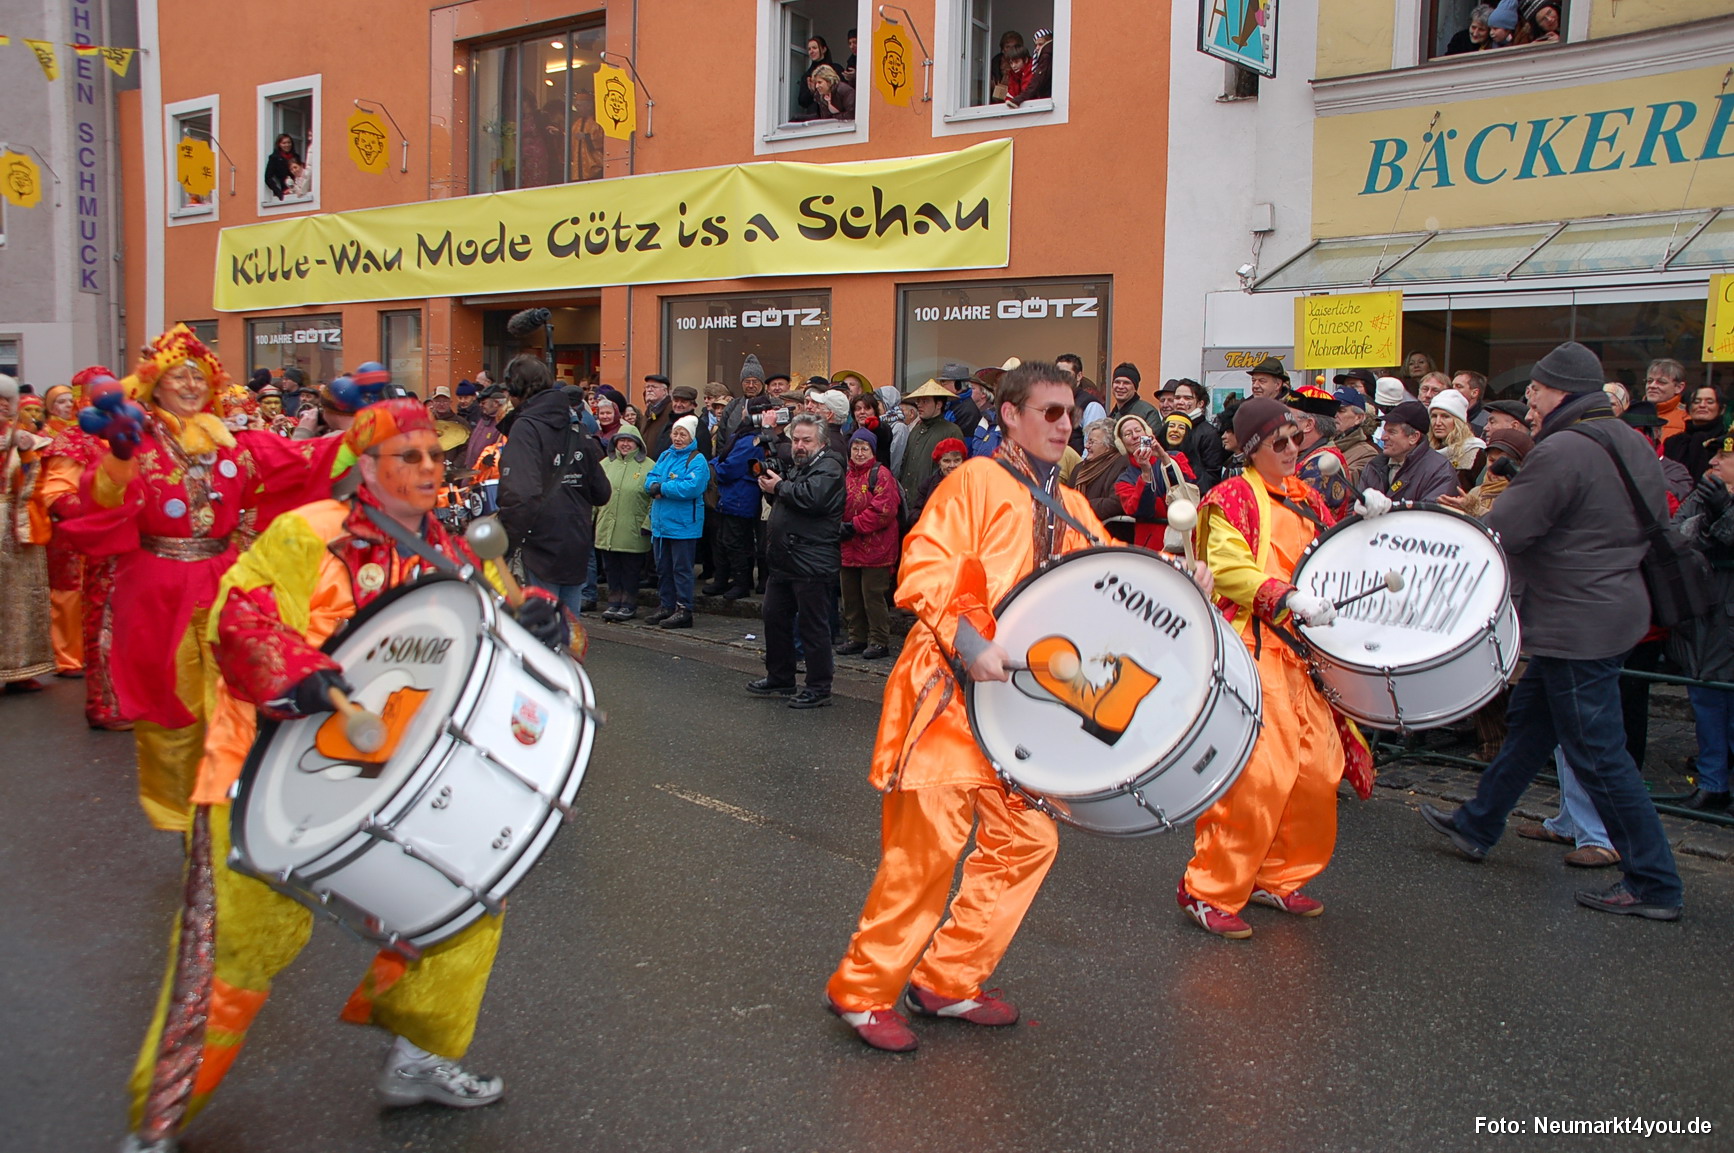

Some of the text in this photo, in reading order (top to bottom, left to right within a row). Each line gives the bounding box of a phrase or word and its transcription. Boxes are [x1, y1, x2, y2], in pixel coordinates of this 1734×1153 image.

[78, 122, 99, 289] SCHMUCK
[232, 185, 989, 287] Kille-Wau Mode Götz is a Schau
[676, 307, 822, 330] 100 JAHRE GÖTZ
[914, 296, 1098, 322] 100 JAHRE GÖTZ
[1308, 300, 1361, 317] Kaiserliche
[255, 327, 341, 345] 100 JAHRE GÖTZ
[1309, 318, 1363, 335] Chinesen
[1307, 335, 1373, 360] Mohrenköpfe
[1388, 534, 1460, 560] SONOR
[1112, 581, 1187, 639] SONOR
[384, 635, 456, 664] SONOR
